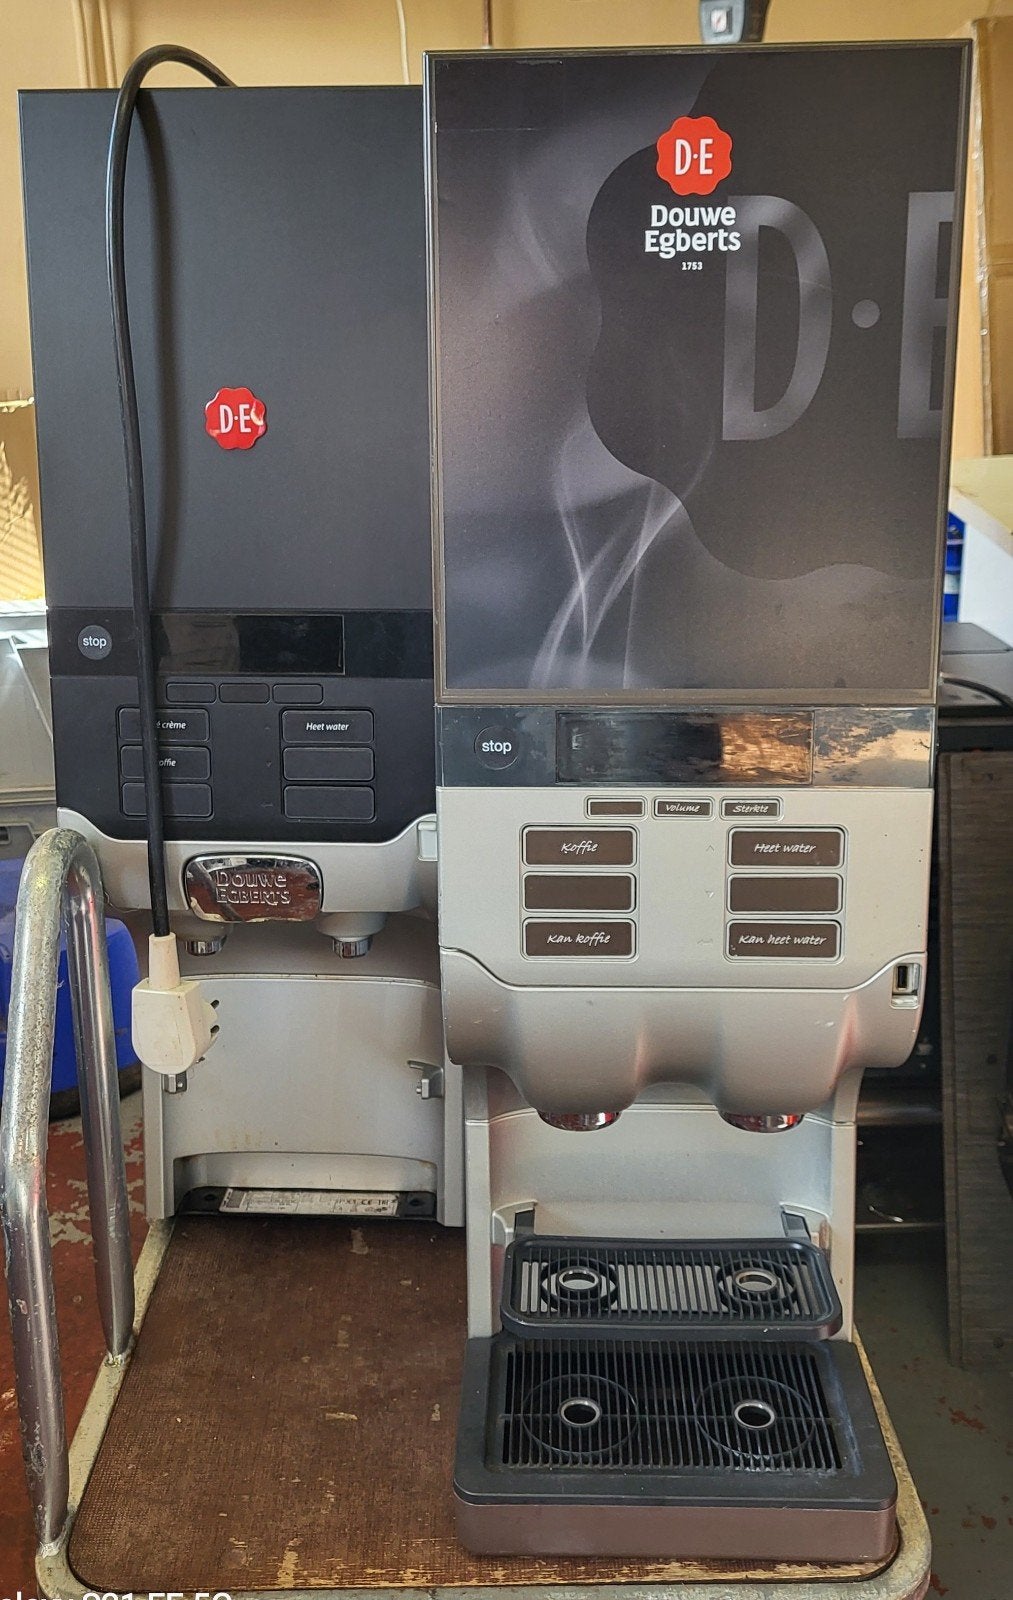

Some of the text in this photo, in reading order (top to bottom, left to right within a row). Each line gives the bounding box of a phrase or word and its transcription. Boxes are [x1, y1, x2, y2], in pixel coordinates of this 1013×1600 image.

[650, 204, 736, 227] Douwe
[644, 228, 741, 259] Egberts
[681, 261, 703, 271] 1753
[82, 635, 107, 649] stop
[161, 720, 187, 729] crème
[306, 722, 349, 730] Heet water
[481, 738, 513, 755] stop
[158, 758, 177, 767] offie
[732, 804, 769, 814] Sterkte
[560, 840, 599, 855] Koffie
[753, 843, 817, 854] Heet water
[546, 932, 611, 946] Kan koffie
[738, 934, 827, 945] Kan heet water
